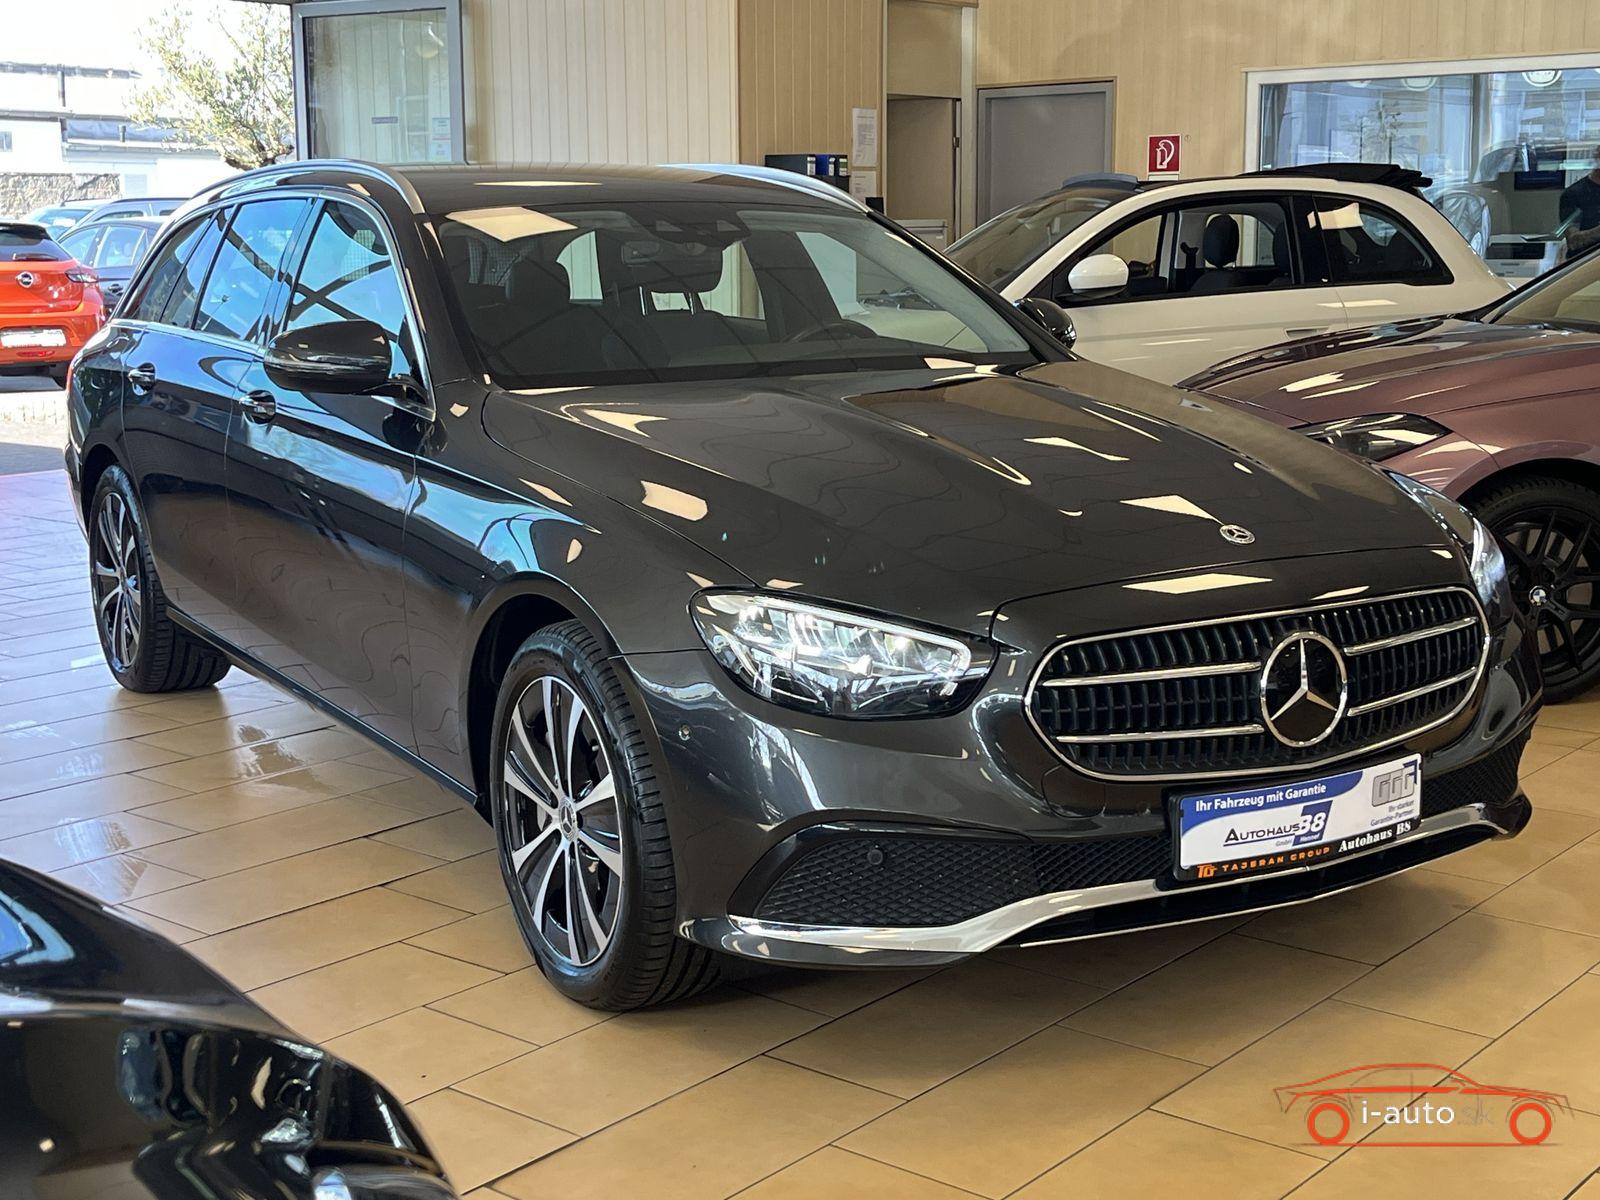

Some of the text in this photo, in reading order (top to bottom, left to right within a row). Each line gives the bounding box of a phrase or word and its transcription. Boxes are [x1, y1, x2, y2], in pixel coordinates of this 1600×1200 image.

[1195, 784, 1327, 812] Ihr Fahrzeug mit Garantie
[1338, 828, 1393, 853] Autohaus
[1290, 846, 1331, 862] GROUP
